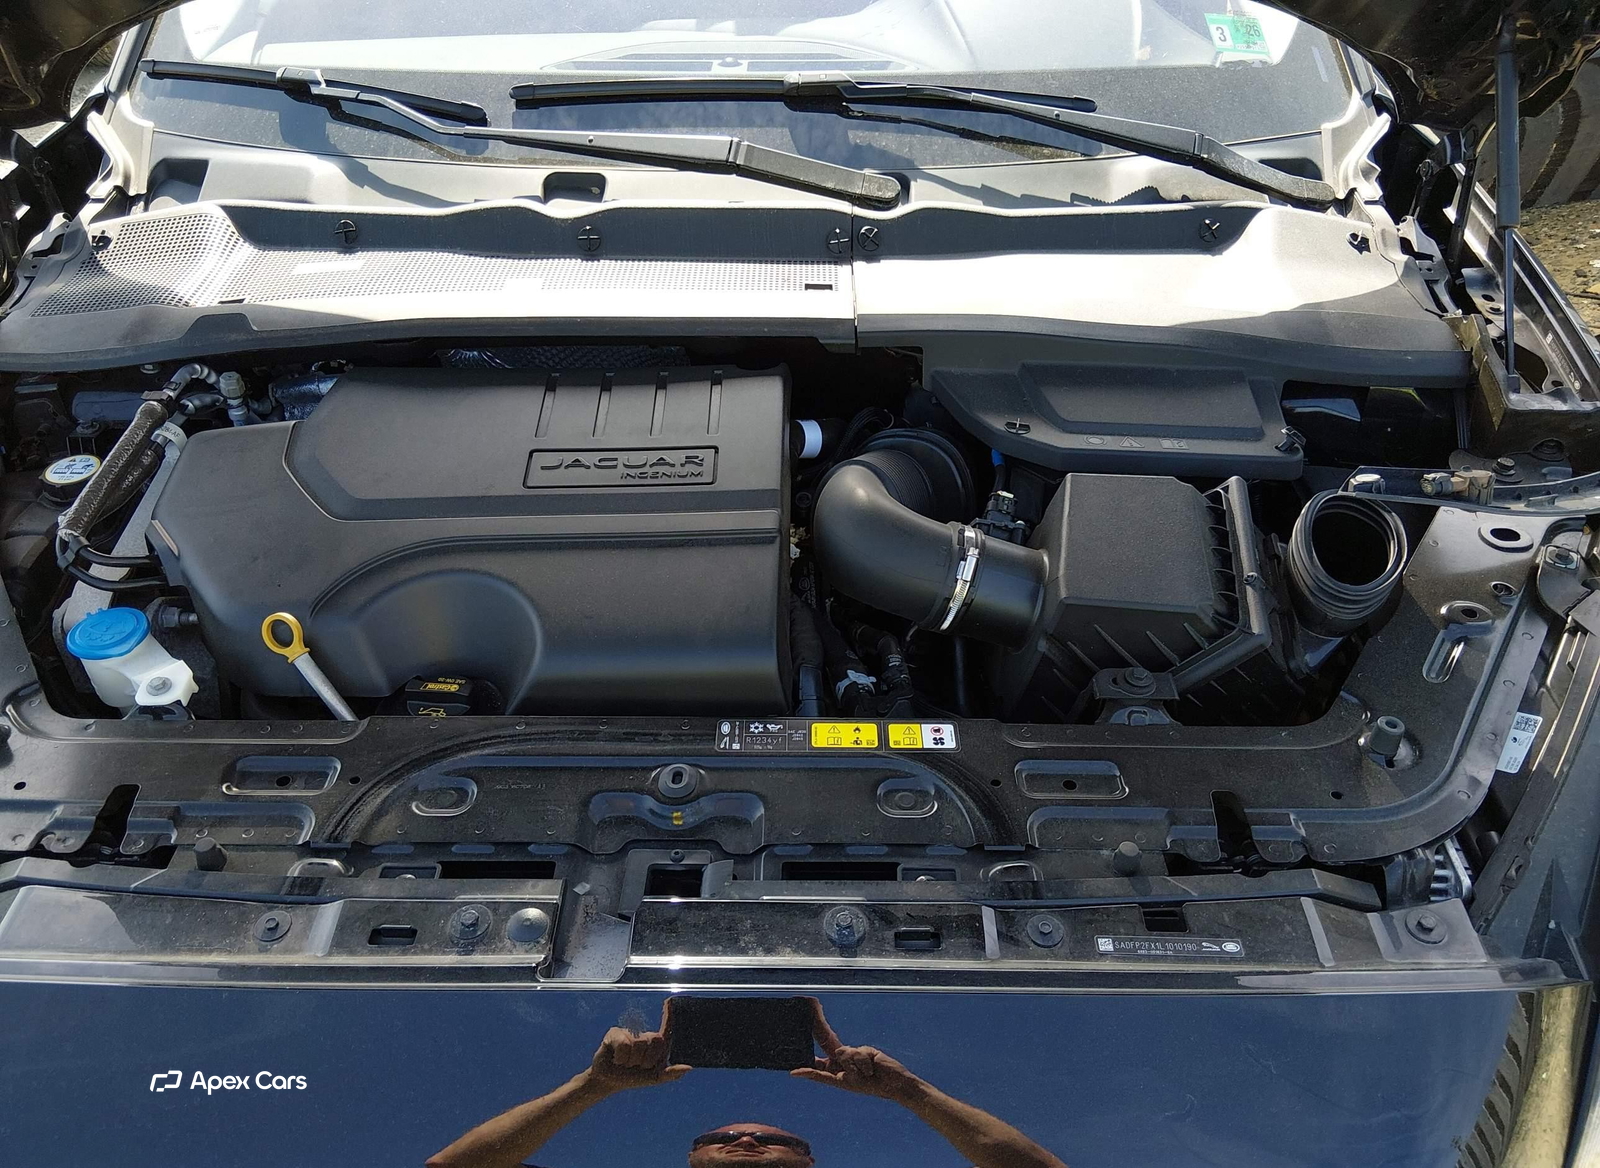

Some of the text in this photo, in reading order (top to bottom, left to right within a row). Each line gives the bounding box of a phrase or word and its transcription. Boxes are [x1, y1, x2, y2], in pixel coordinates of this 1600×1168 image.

[1215, 24, 1261, 42] 3 26
[540, 454, 705, 470] JAGUAR
[620, 470, 704, 480] INGENIUM
